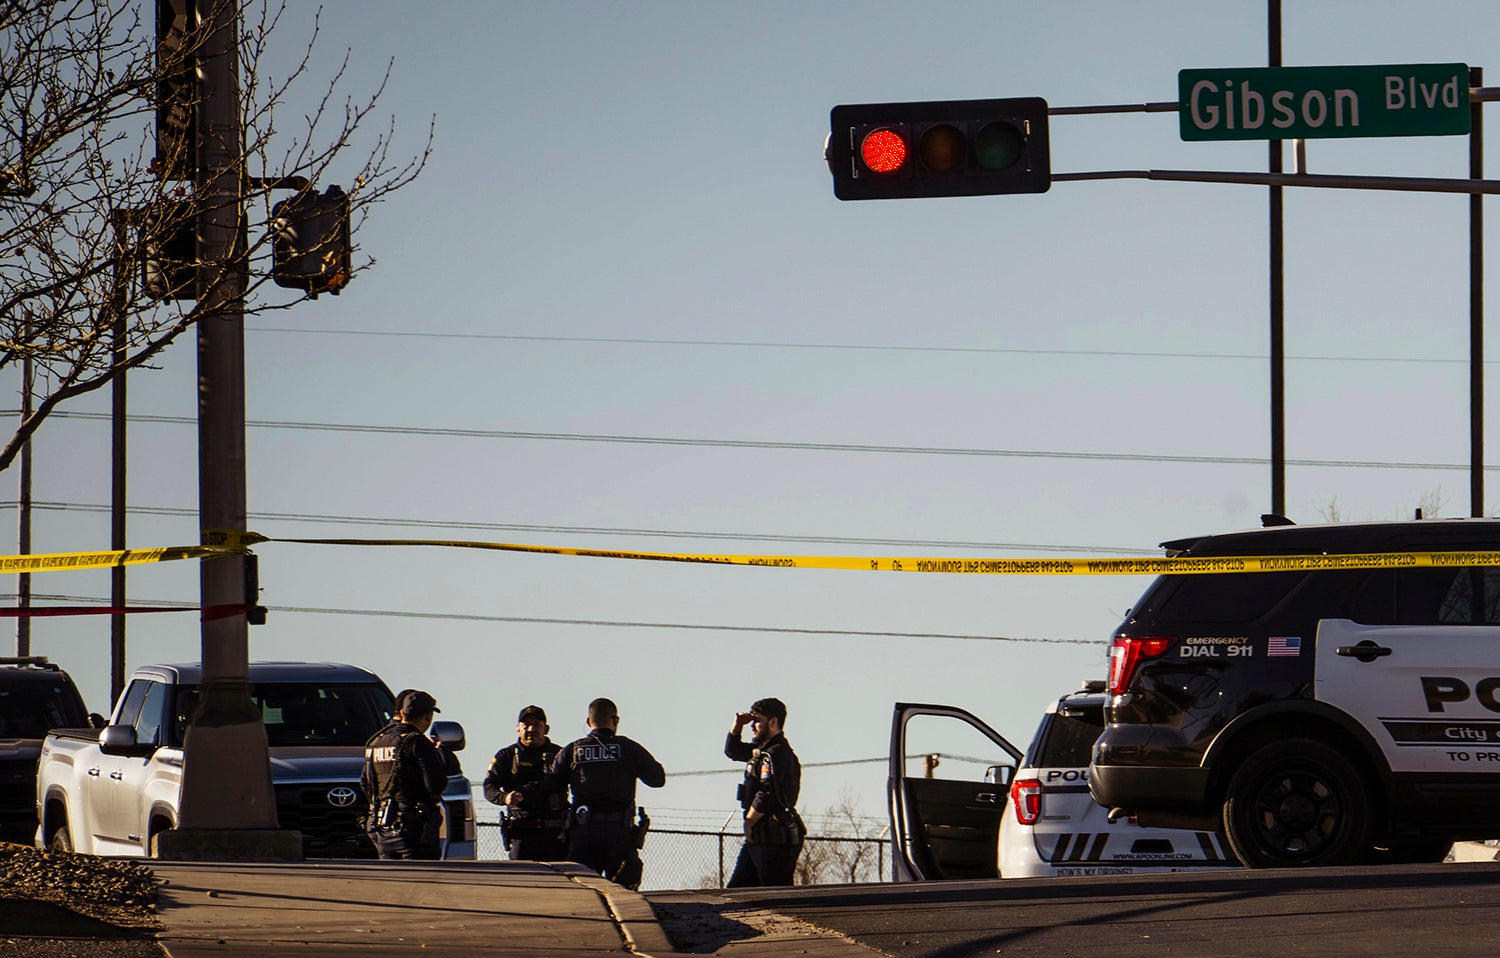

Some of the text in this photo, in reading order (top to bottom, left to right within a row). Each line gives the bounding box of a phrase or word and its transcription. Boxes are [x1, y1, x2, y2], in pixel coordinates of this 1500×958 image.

[1190, 75, 1459, 129] Gibson Blvd
[1186, 637, 1249, 645] EMERGENCY
[1180, 645, 1253, 657] DIAL 911
[1445, 727, 1488, 742] City
[373, 746, 396, 762] POLICE
[577, 745, 617, 761] POLICE
[1447, 751, 1470, 762] TO
